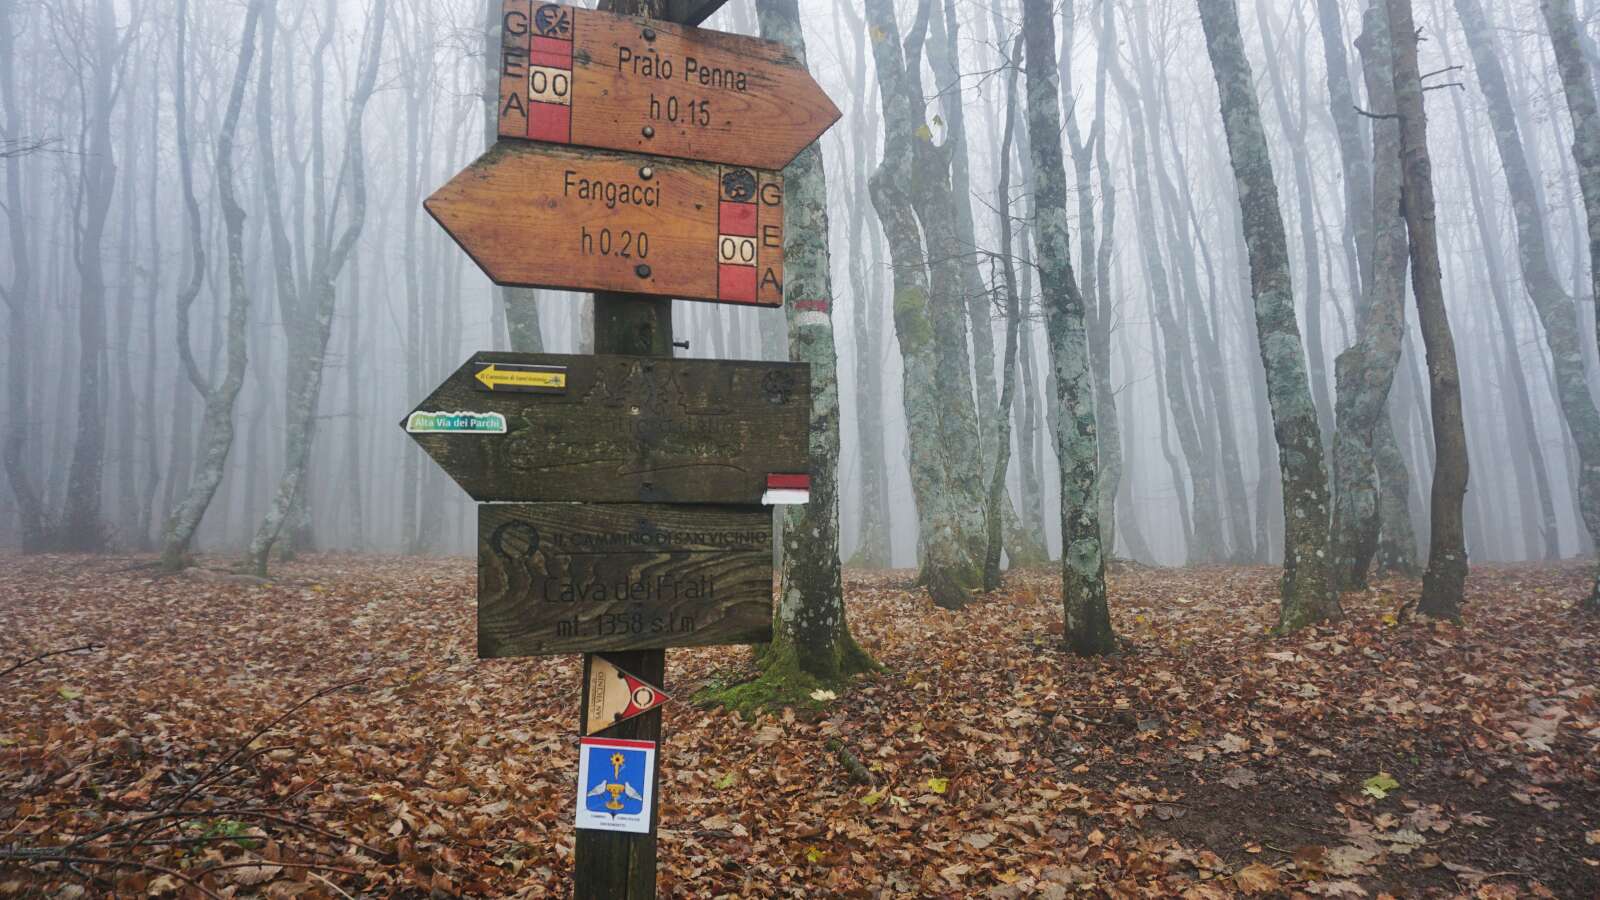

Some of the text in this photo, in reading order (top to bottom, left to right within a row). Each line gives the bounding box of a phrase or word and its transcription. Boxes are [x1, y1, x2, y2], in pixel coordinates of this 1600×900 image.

[619, 47, 747, 92] Prato Penna
[531, 71, 569, 97] 00
[564, 170, 660, 209] Fangacci
[720, 239, 755, 263] 00
[417, 417, 499, 428] Alta Via dei Parchi
[574, 533, 653, 546] CAMMINO
[675, 532, 704, 545] SAN
[708, 531, 768, 544] VICINIO
[544, 575, 713, 603] Cava dei Frati
[599, 614, 643, 635] 1358
